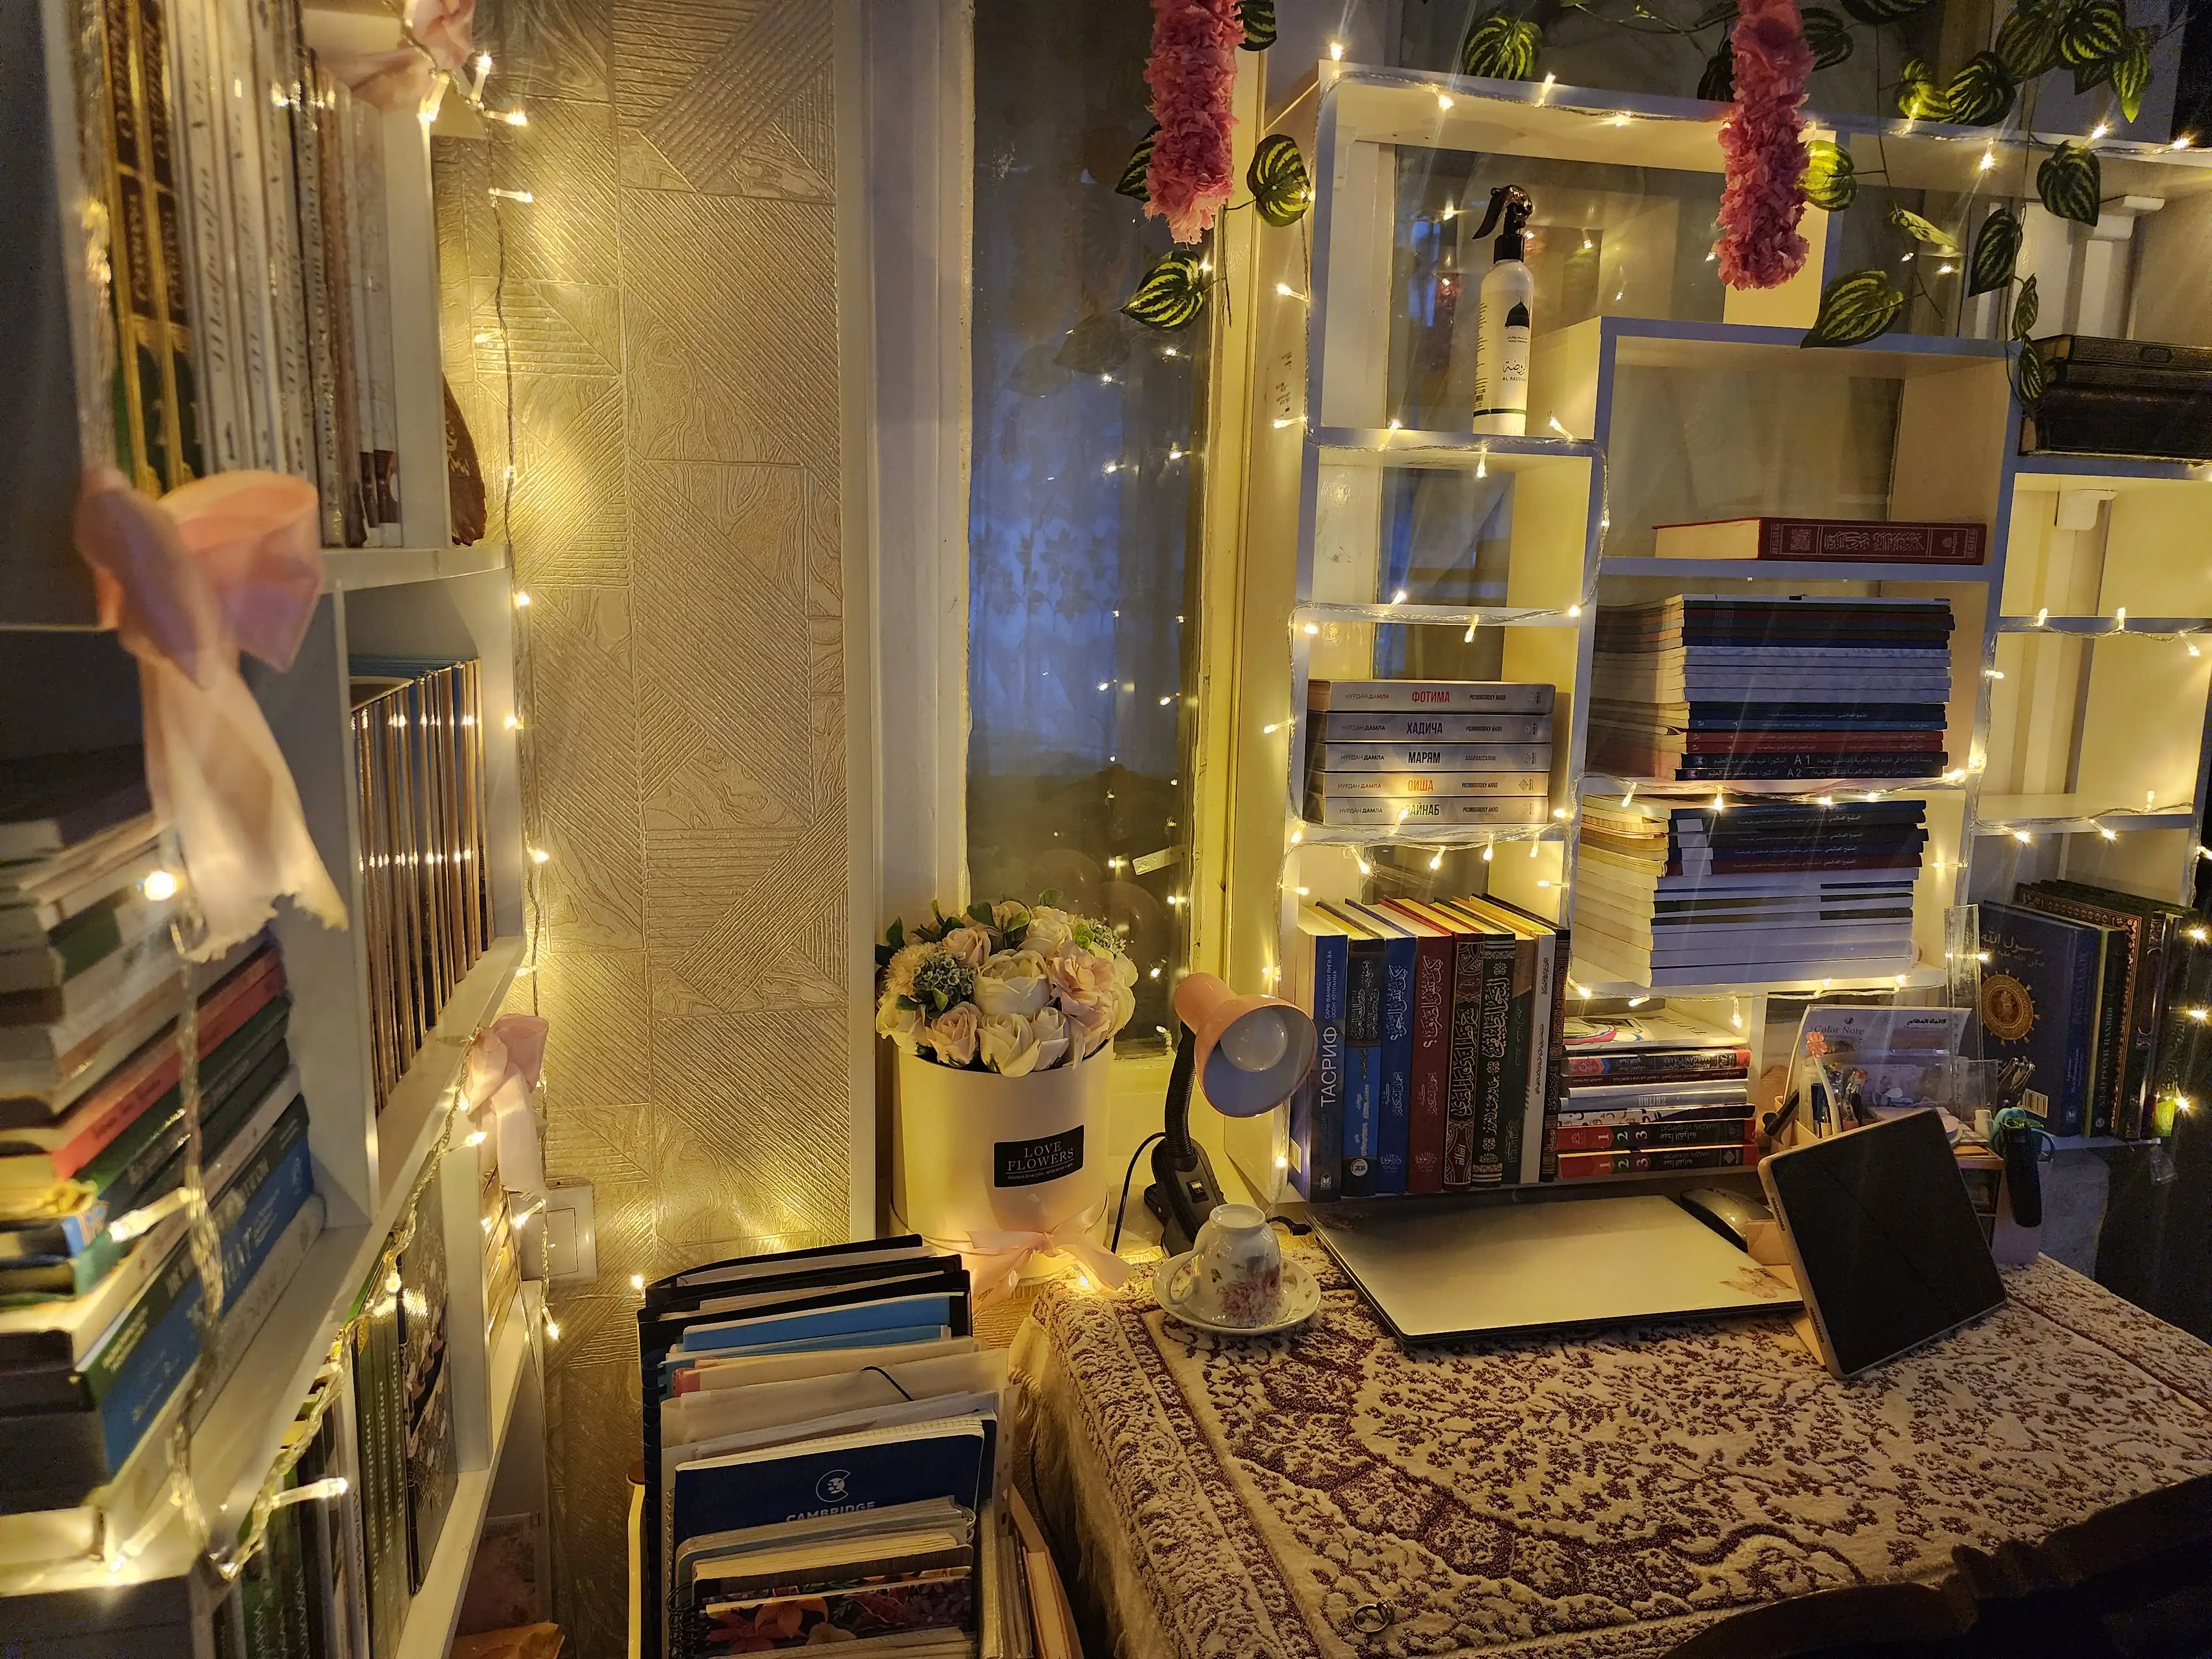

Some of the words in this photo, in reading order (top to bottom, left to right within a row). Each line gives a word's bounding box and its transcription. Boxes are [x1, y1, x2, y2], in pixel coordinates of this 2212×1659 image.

[1412, 691, 1450, 702] ФОТИМА
[1406, 722, 1442, 735] ХАДИЧА
[1408, 752, 1441, 763] МАРЯМ
[1408, 780, 1433, 791] ОИША
[1980, 927, 2004, 945] الله
[1814, 1025, 1841, 1035] Color
[1842, 1026, 1864, 1035] Note
[1321, 1027, 1337, 1107] ТАСРИФ
[1598, 1134, 1610, 1144] 1
[1618, 1131, 1628, 1141] 2
[1636, 1130, 1647, 1140] 3
[1024, 1141, 1061, 1158] LOVE
[1007, 1148, 1074, 1171] FLOWERS
[1619, 1160, 1629, 1169] 2
[1637, 1157, 1648, 1167] 3
[1046, 1166, 1065, 1175] wherever
[786, 1501, 876, 1522] CAMBRIDGE
